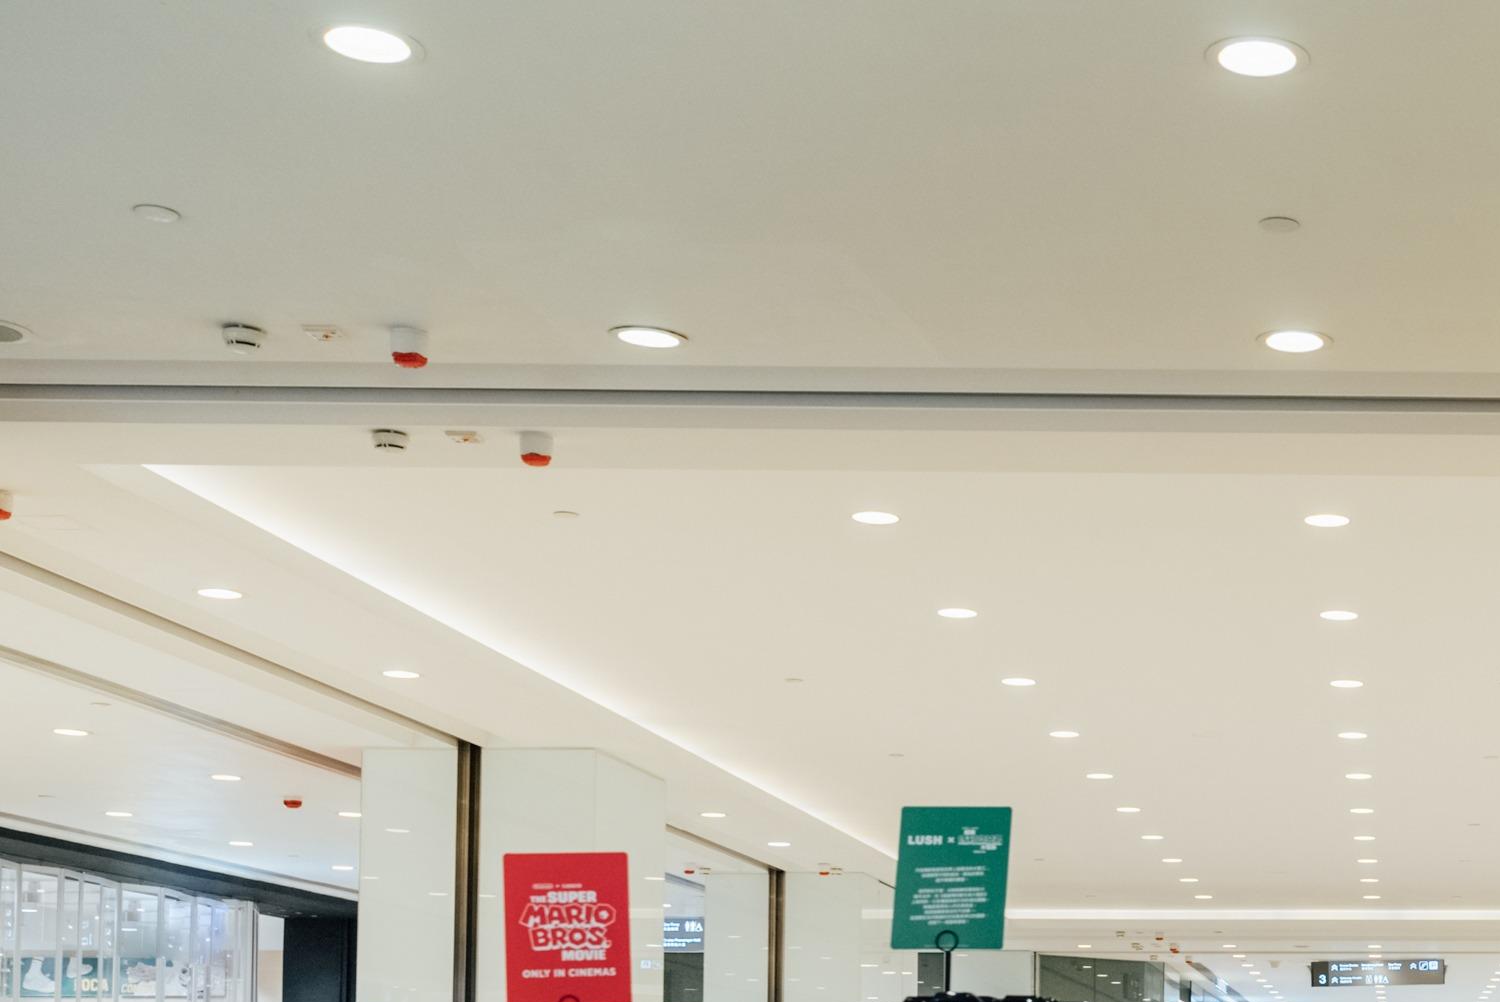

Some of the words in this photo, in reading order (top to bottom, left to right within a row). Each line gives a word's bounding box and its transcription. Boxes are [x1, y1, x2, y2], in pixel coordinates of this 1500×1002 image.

[907, 835, 943, 845] LUSH
[547, 890, 597, 903] SUPER
[519, 903, 616, 927] MARIO
[529, 926, 612, 951] BROS.
[561, 949, 606, 961] MOVIE
[522, 969, 550, 978] ONLY
[554, 969, 566, 977] IN
[568, 967, 616, 977] CINEMAS
[1318, 974, 1327, 984] 3
